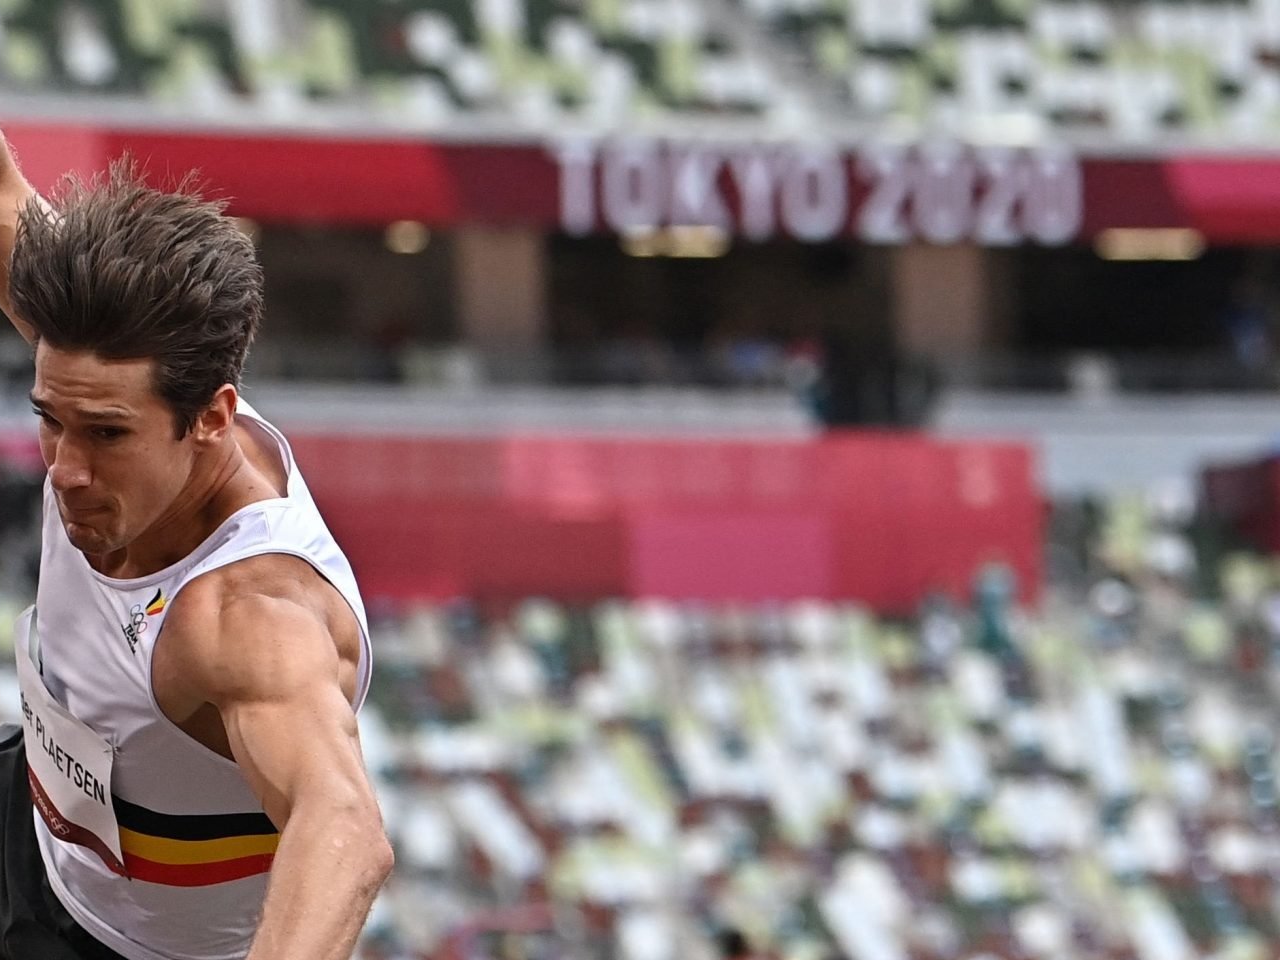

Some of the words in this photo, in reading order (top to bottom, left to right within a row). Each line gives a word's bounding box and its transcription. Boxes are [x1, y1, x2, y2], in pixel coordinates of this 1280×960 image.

[548, 137, 847, 241] TOKYO
[853, 142, 1083, 246] 2020
[35, 714, 106, 806] PLAETSEN
